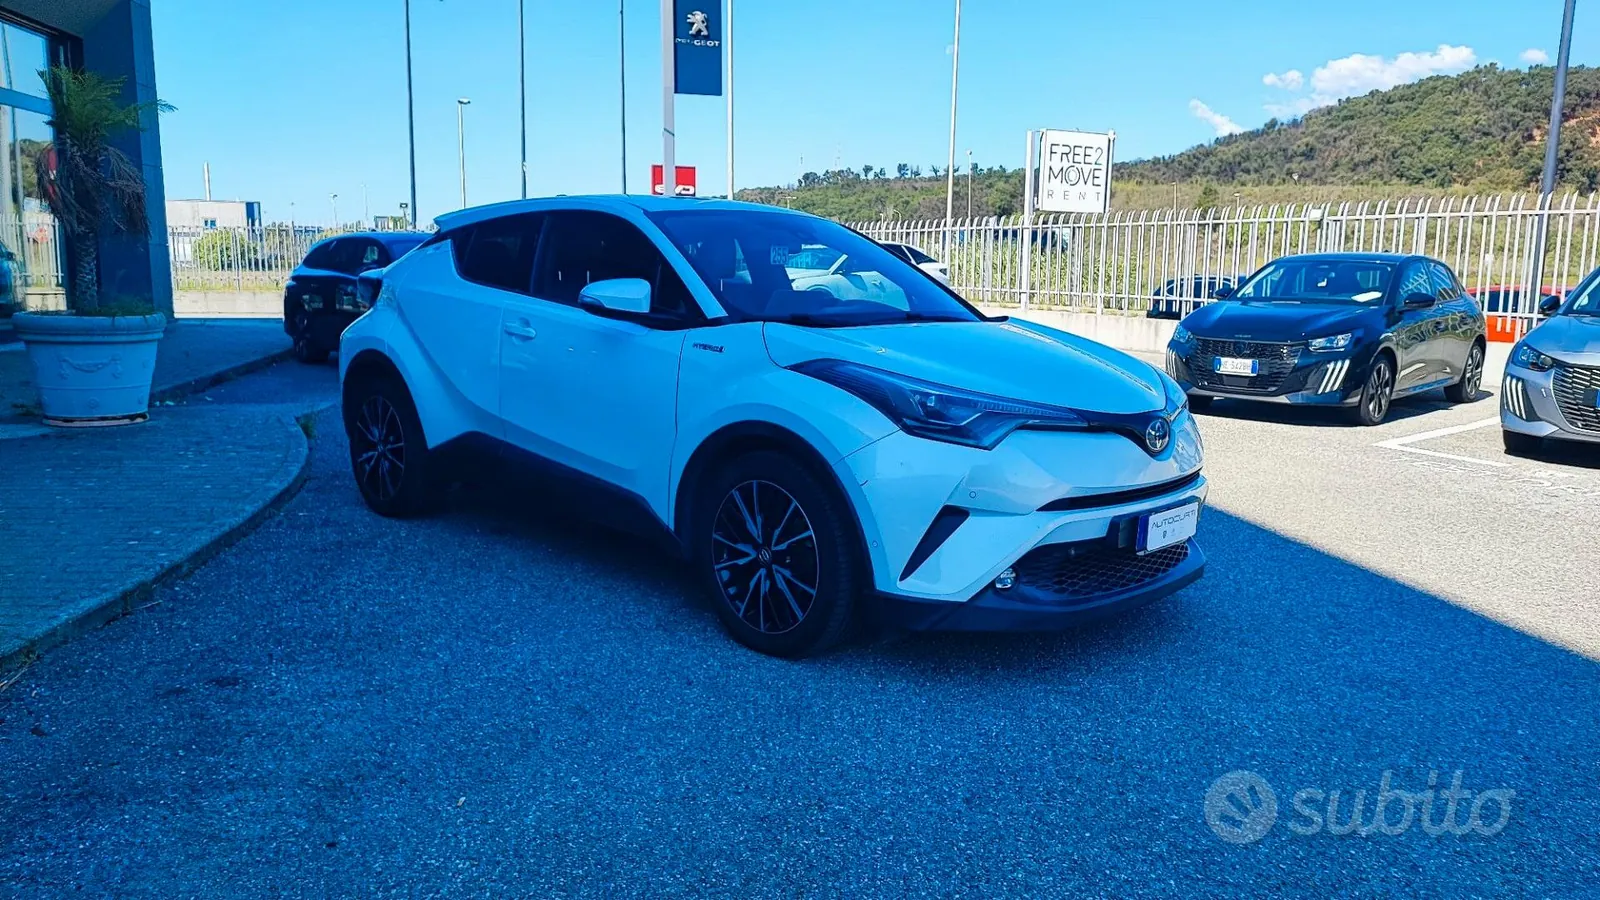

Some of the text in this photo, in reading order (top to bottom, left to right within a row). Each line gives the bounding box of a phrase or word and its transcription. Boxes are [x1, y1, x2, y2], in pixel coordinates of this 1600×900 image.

[1049, 143, 1104, 165] FREE2
[1048, 165, 1102, 187] MOVE
[1047, 190, 1101, 201] RENT
